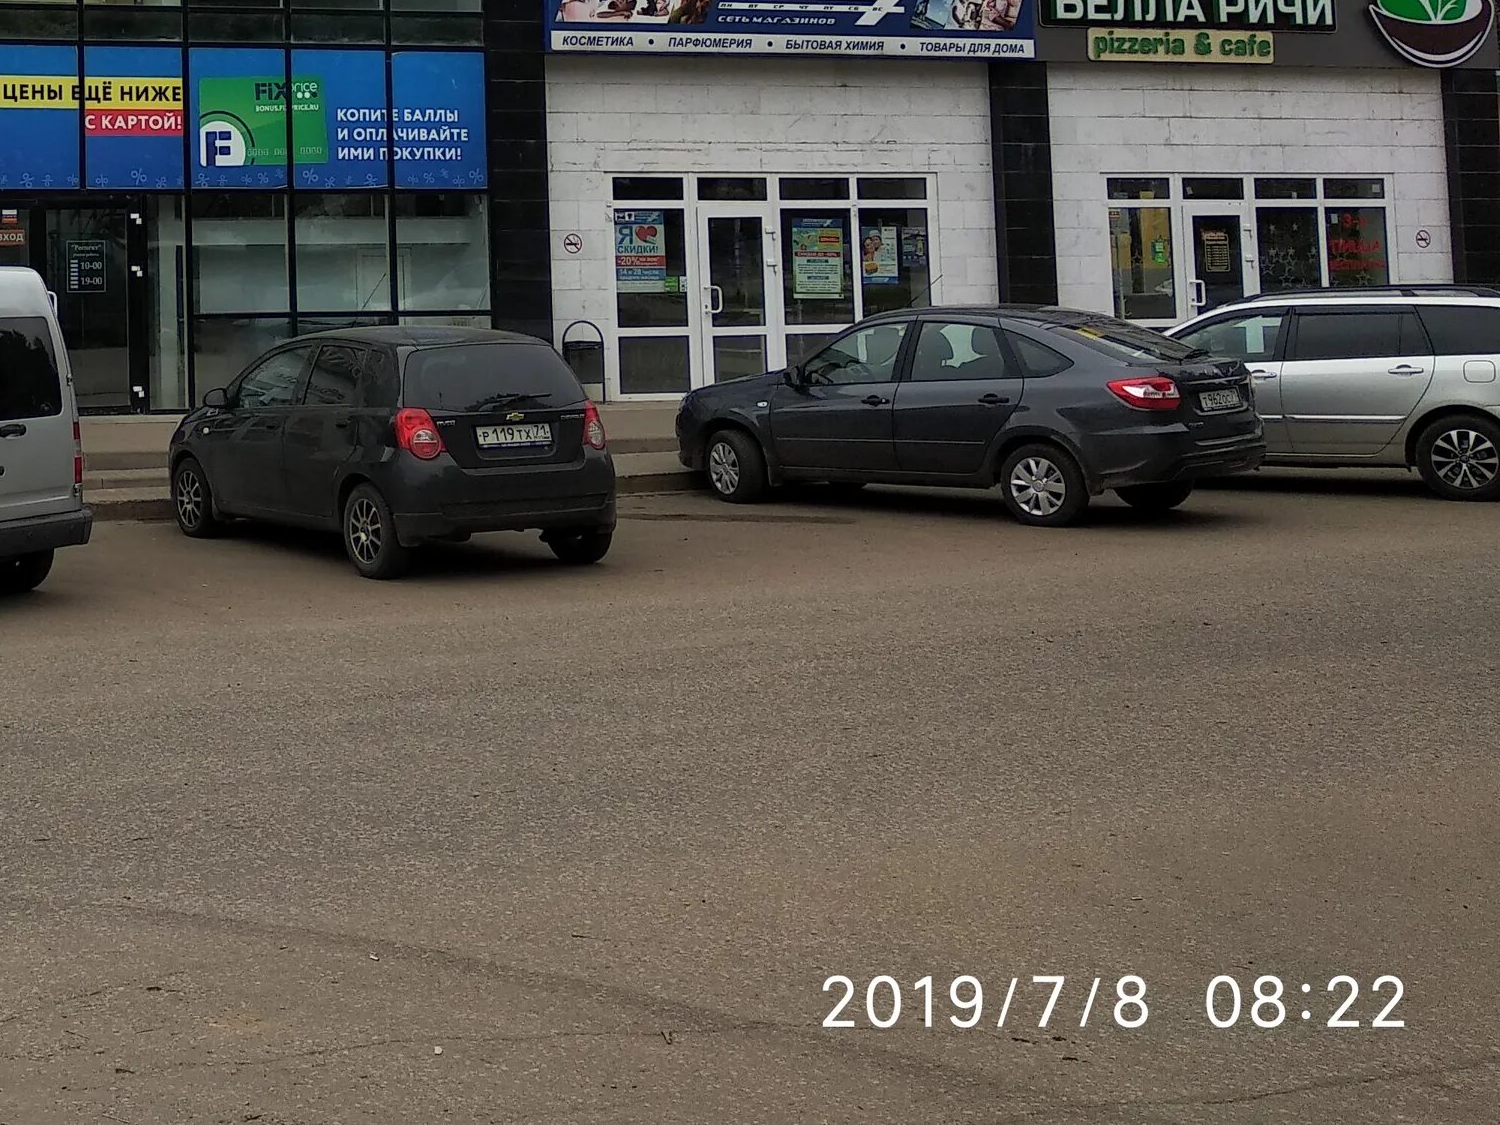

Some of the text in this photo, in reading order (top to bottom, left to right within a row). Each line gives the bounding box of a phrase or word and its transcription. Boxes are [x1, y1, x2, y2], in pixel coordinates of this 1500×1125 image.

[717, 15, 836, 25] СЕТЬ МАГАЗИНОВ
[562, 35, 1025, 54] КОСМЕТИКА ПАРФЮМЕРИЯ БЫТОВАЯ ХИМИЯ ТОВАРЫ ДЛЯ ДОМА
[1092, 30, 1272, 58] pizzeria & cafe
[3, 83, 63, 102] ЦЕНЫ
[120, 85, 182, 102] НИЖЕ
[85, 112, 182, 130] С КАРТОЙ!
[336, 108, 459, 123] КОПИТЕ БАЛЛЫ
[337, 125, 469, 142] И ОПЛАЧИВАЙТЕ
[337, 147, 462, 161] ИМИ ПОКУПКИ!
[618, 225, 634, 245] Я
[617, 245, 659, 254] СКИДКИ!
[482, 424, 547, 443] Р119ТХ 71
